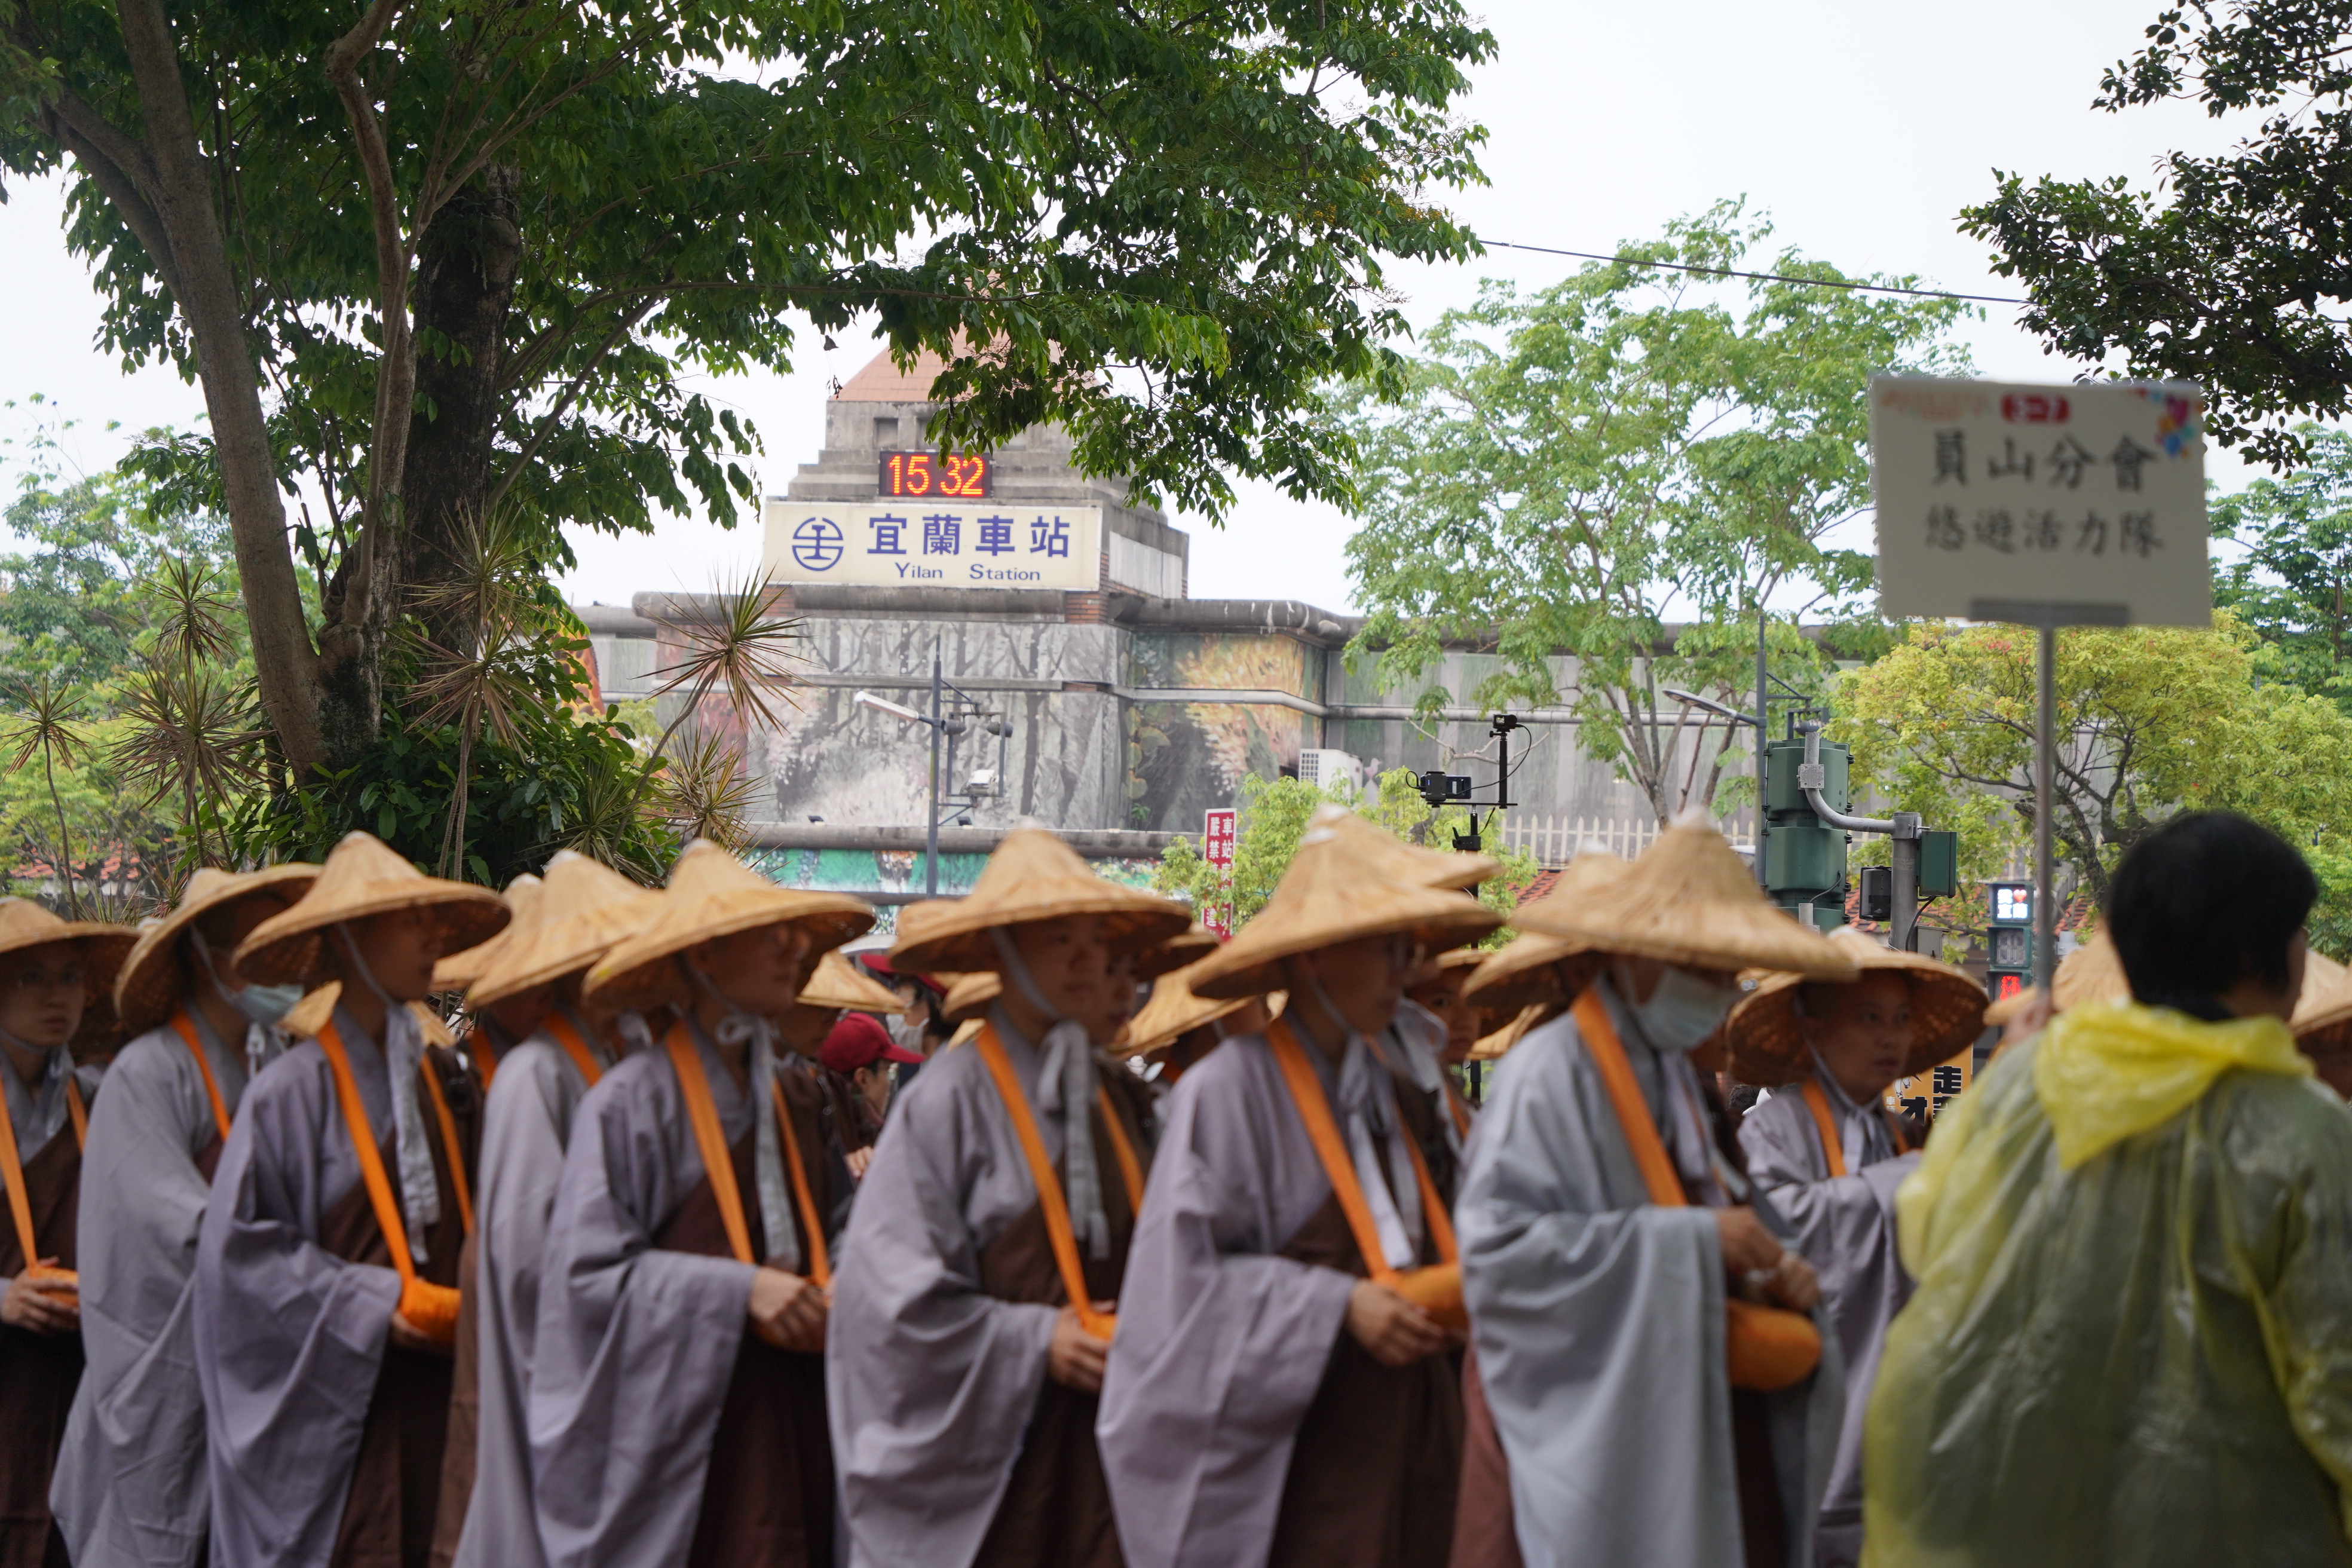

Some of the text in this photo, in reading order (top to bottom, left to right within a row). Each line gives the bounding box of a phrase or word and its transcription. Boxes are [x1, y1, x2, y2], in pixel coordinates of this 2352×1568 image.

[1932, 427, 2158, 493] 員山分會
[867, 513, 1070, 558] 宜蘭車站
[895, 562, 1041, 581] Yilan Station
